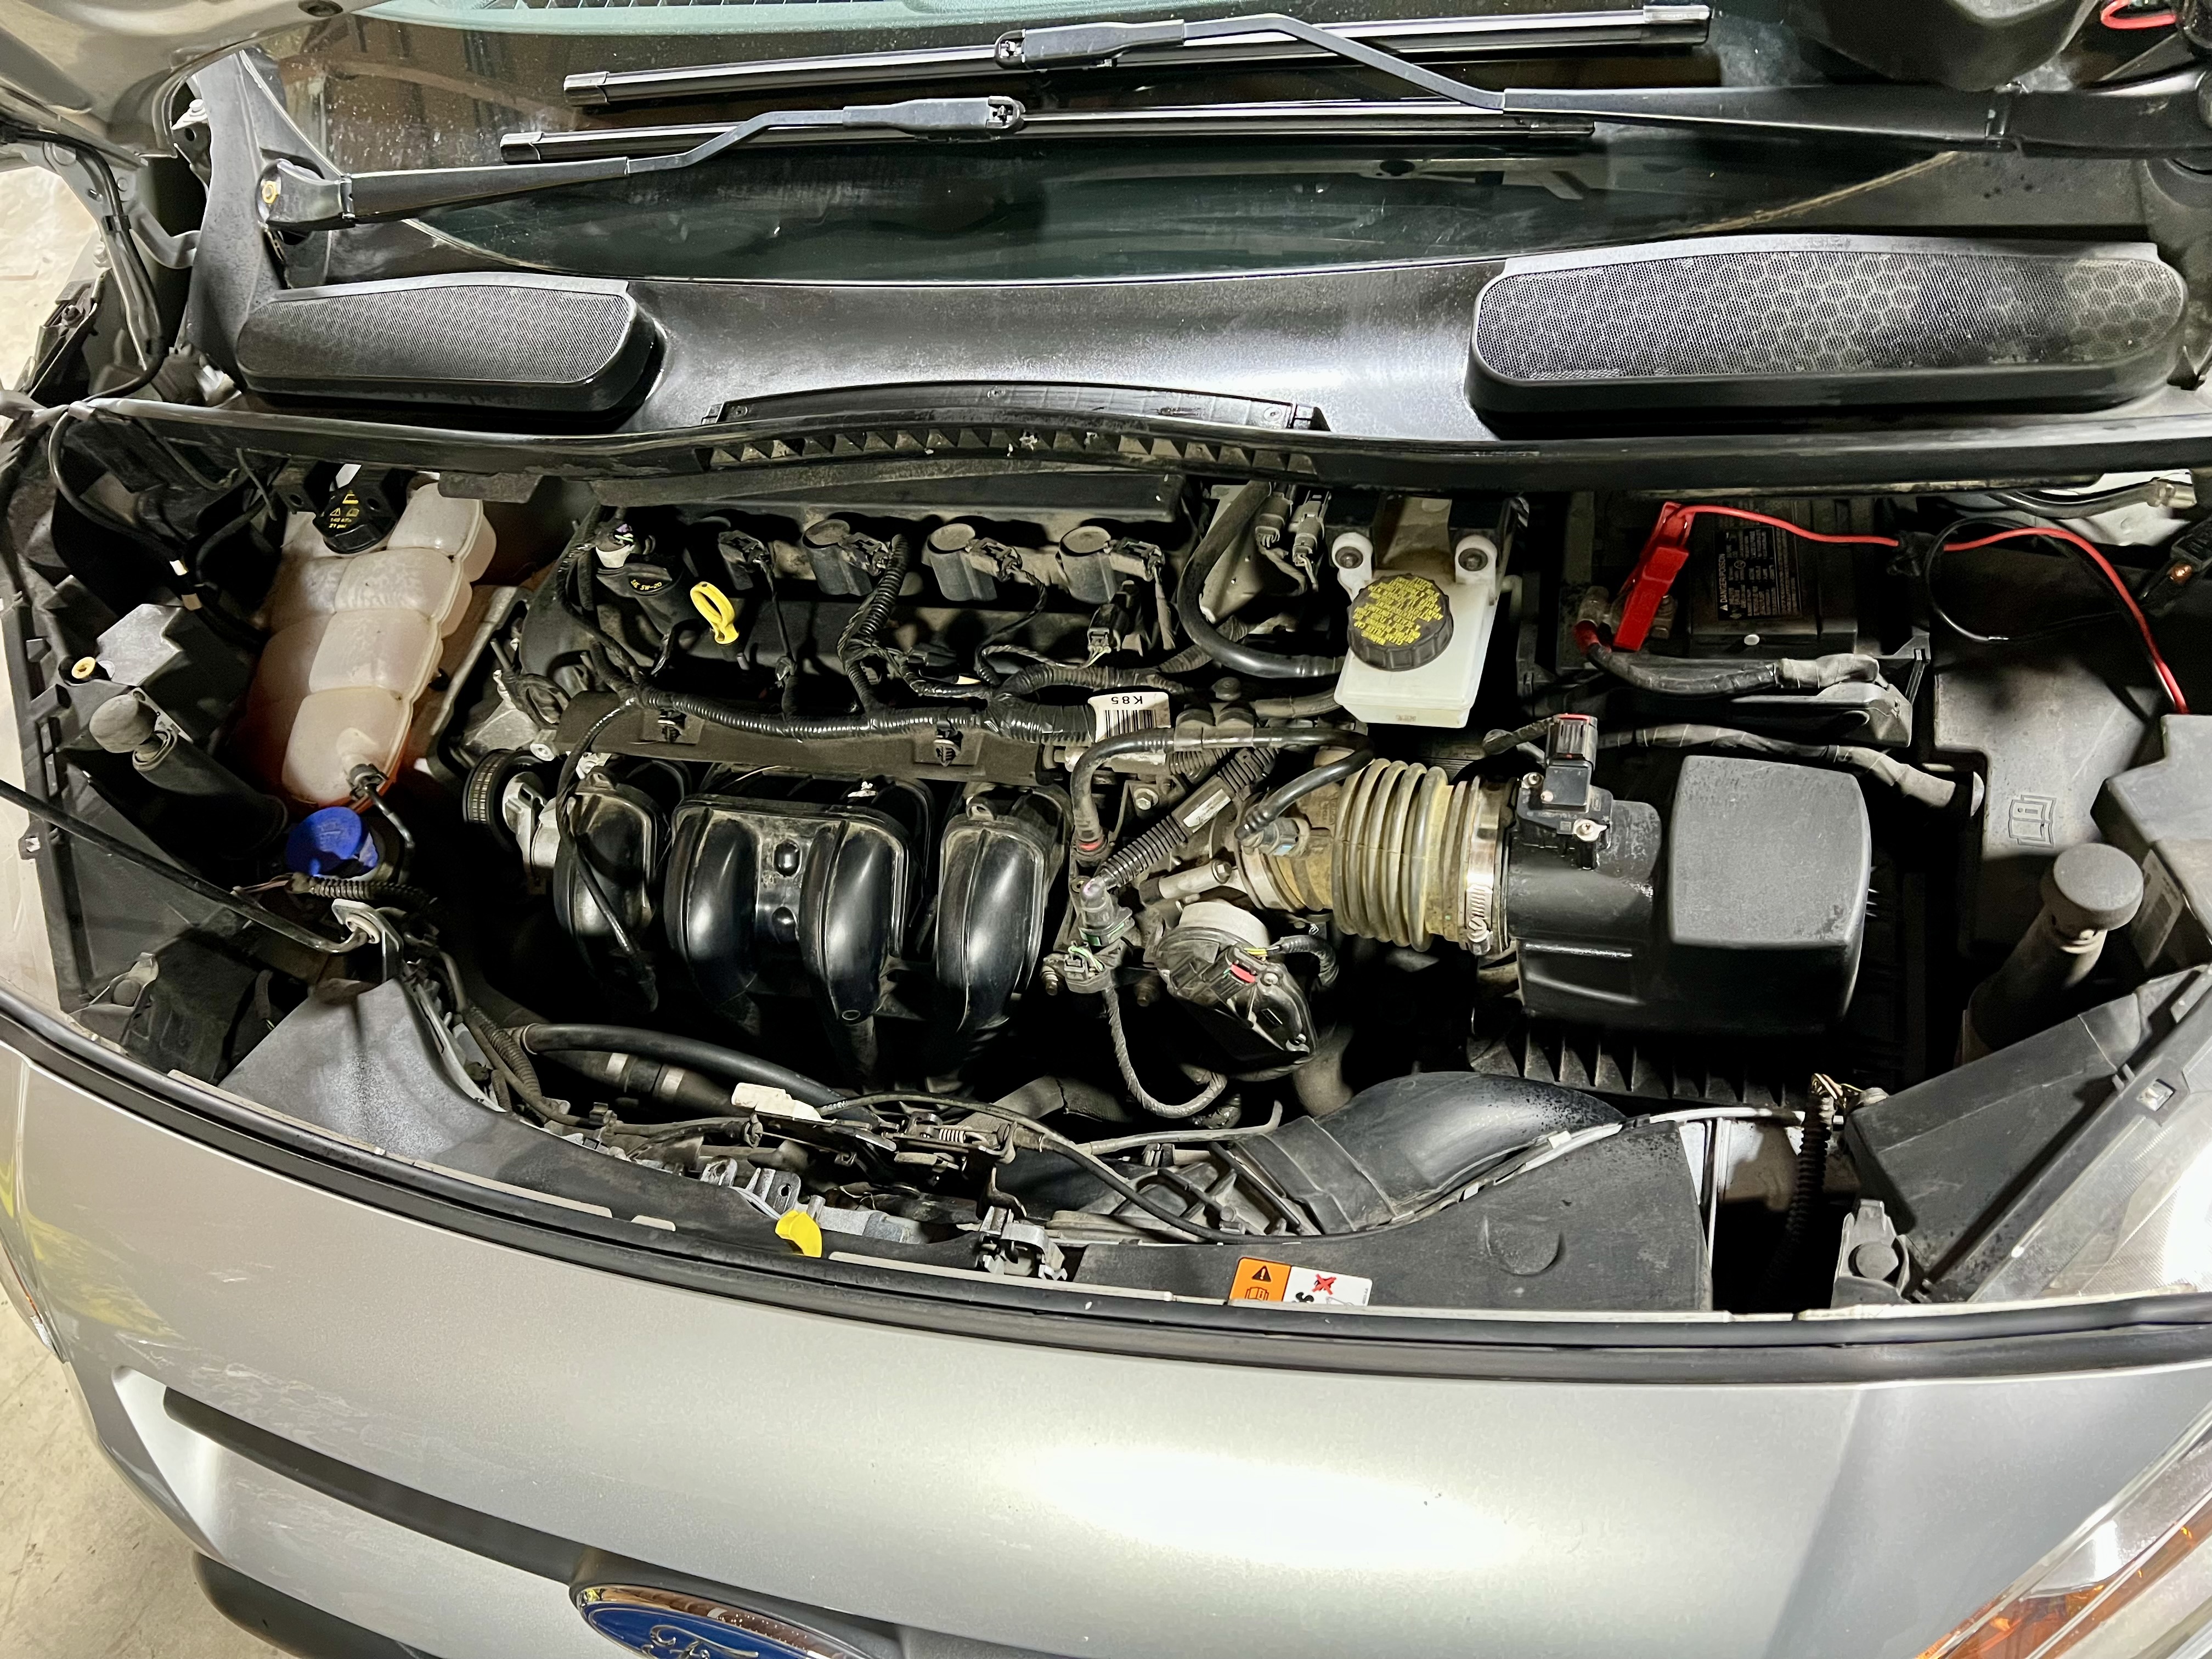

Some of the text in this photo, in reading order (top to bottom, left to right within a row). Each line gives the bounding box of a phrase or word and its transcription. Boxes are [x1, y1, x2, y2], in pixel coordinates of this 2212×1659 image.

[630, 579, 663, 590] SAE 5W-20
[1353, 620, 1366, 629] CAP
[1405, 628, 1421, 639] ONLY
[1384, 633, 1403, 646] CLEAN
[1111, 696, 1143, 705] K85
